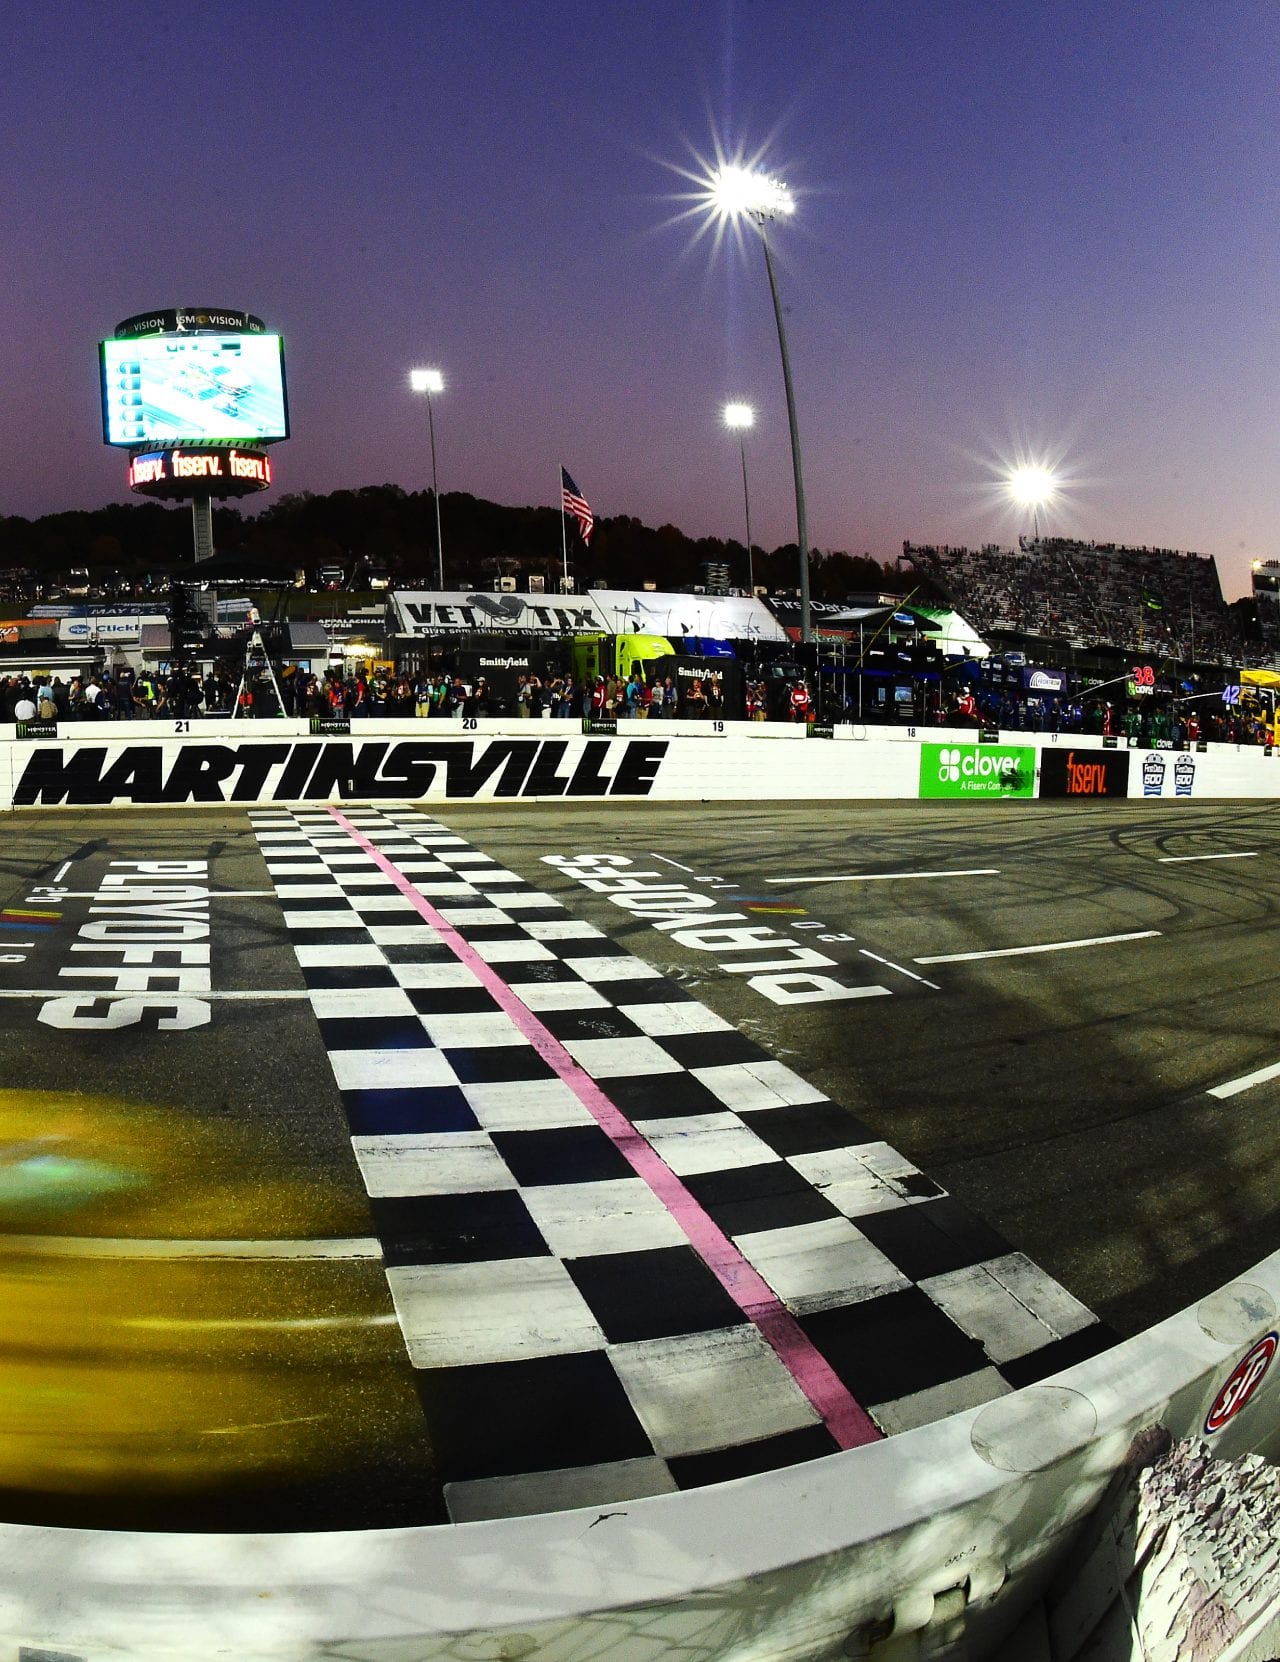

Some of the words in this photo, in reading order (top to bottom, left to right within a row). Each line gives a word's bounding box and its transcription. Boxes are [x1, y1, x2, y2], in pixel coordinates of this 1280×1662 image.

[134, 318, 165, 332] VISION
[209, 316, 242, 327] VISION
[172, 450, 222, 477] fiserv.
[771, 598, 802, 609] Firs
[405, 603, 474, 626] VET
[526, 606, 601, 628] TIX
[479, 657, 528, 669] Smithfield
[1132, 666, 1155, 686] 38
[1222, 685, 1240, 704] 42
[175, 721, 190, 733] 21
[462, 718, 477, 730] 20
[712, 722, 724, 732] 19
[907, 728, 916, 738] 18
[1051, 734, 1058, 743] 17
[962, 749, 1020, 776] clover
[13, 741, 669, 804] MARTINSVILLE
[1067, 752, 1107, 793] fiserv.
[967, 781, 987, 790] Fiserv
[1144, 774, 1161, 785] 500
[1176, 775, 1192, 784] 500
[540, 853, 893, 1005] PLAYOFFS
[36, 860, 212, 1030] PLAYOFFS
[1213, 1346, 1268, 1420] STP
